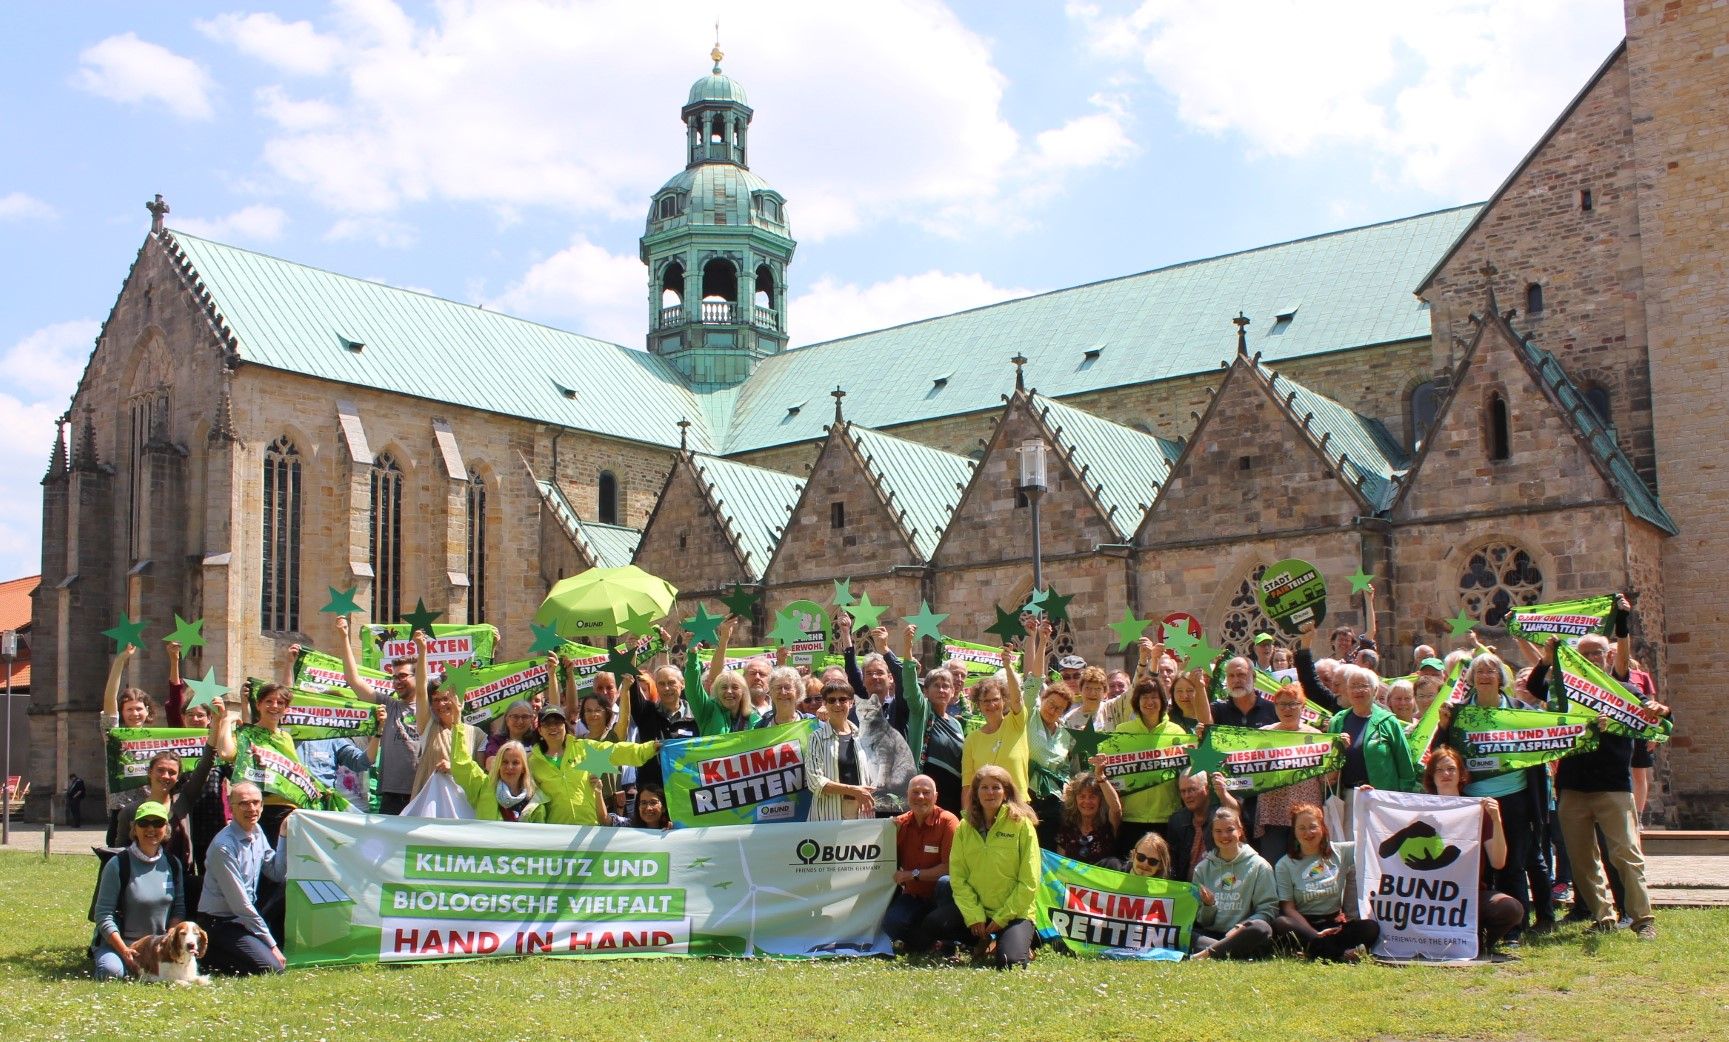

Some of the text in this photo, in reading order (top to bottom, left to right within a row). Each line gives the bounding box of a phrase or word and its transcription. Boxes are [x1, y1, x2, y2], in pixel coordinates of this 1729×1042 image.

[1264, 574, 1290, 592] STADT
[388, 638, 469, 657] INSKTEN
[950, 653, 1004, 667] STATT ASPHA
[500, 674, 521, 688] UND
[522, 664, 547, 678] WAL
[471, 675, 547, 709] STATT ASPHALT
[1601, 690, 1625, 708] UND
[308, 707, 332, 718] UND
[335, 709, 368, 719] WALD
[1564, 687, 1646, 731] TATT ASPHALT
[279, 715, 359, 728] TATT ASPHALT
[172, 737, 197, 748] UND
[1468, 725, 1583, 742] WIESEN UND WALD
[1268, 748, 1293, 759] UND
[1296, 743, 1330, 755] WALD
[1478, 737, 1574, 754] STATT ASPHALT
[702, 743, 800, 785] KLIMA
[1138, 750, 1161, 760] UND
[1105, 756, 1189, 776] STATT ASPHALT
[1232, 756, 1321, 774] STATT ASPHALT
[769, 805, 789, 814] BUND
[822, 844, 881, 862] BUND
[416, 853, 659, 877] KLIMASCHUTZ UND
[1379, 873, 1460, 902] BUND
[393, 890, 673, 914] BIOLOGISCHE VIELFALT
[1067, 886, 1168, 923] KLIMA
[1052, 910, 1177, 950] RETTEN!
[394, 928, 674, 954] HAND IN HAND
